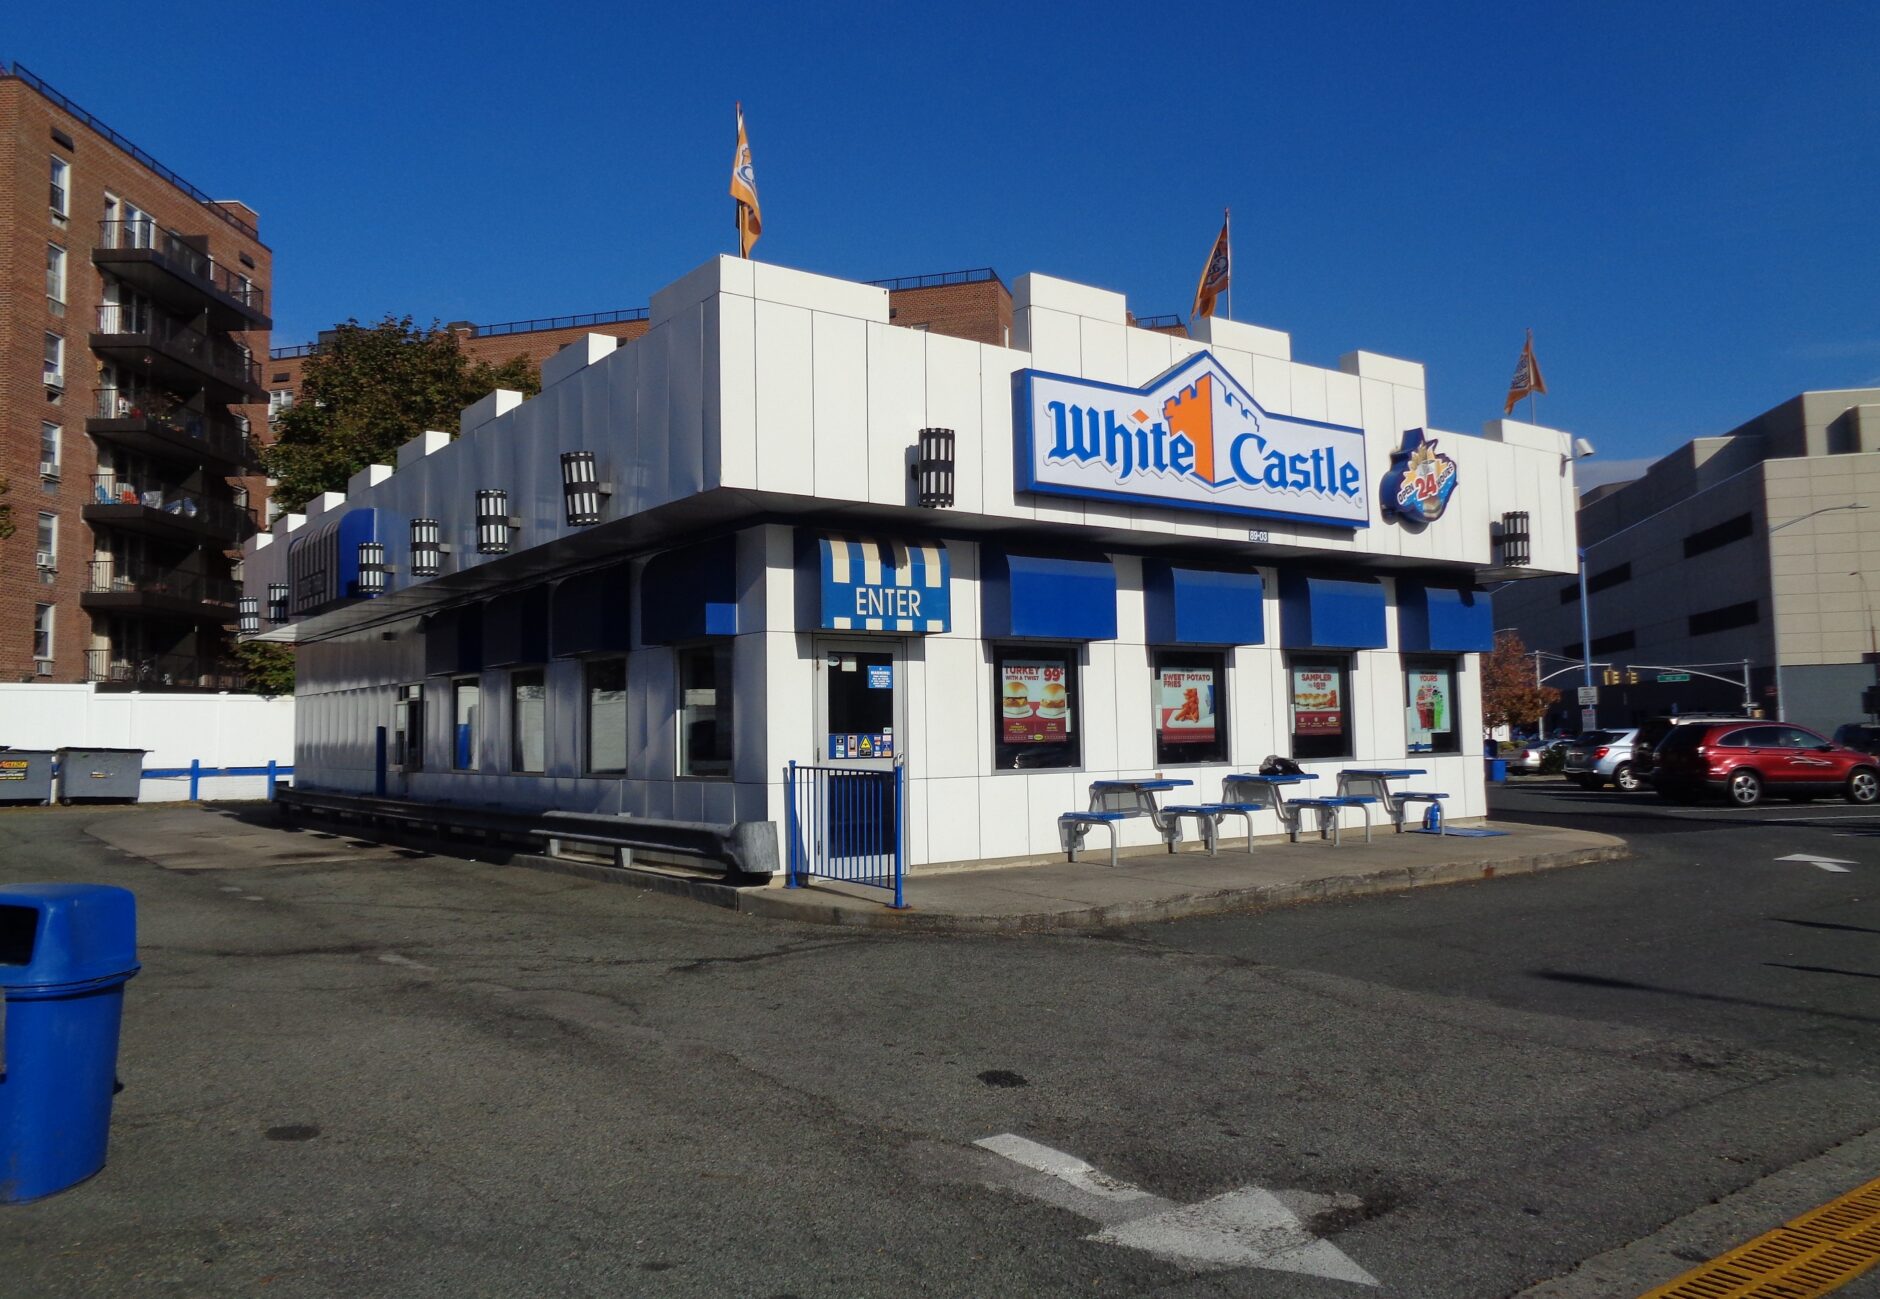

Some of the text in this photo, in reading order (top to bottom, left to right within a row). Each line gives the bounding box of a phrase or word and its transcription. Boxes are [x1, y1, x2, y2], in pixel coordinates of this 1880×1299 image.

[1047, 400, 1360, 497] White Castle
[1398, 463, 1455, 503] OPEN 24 HOURS
[1250, 530, 1268, 542] 89-03
[855, 587, 921, 617] ENTER
[1004, 665, 1040, 675] TURKEY
[1163, 673, 1211, 682] SWEET POTATO
[1301, 673, 1332, 682] SAMPLER
[1419, 674, 1438, 682] YOURS
[1163, 680, 1181, 688] FRIES
